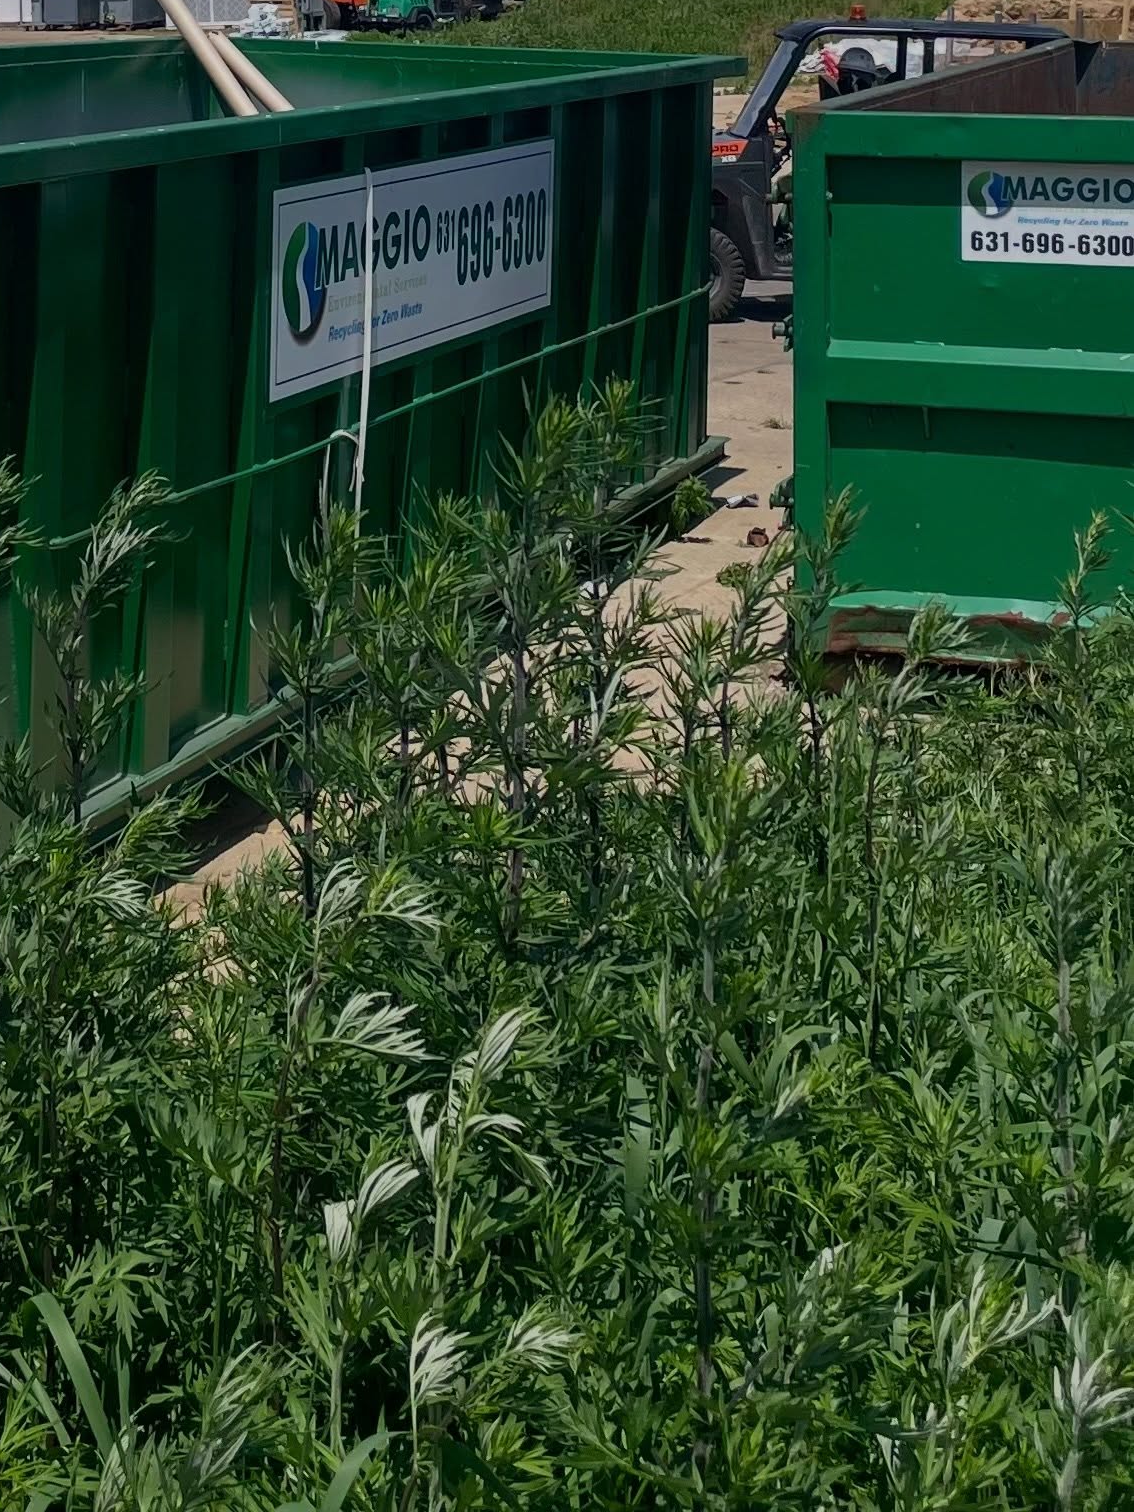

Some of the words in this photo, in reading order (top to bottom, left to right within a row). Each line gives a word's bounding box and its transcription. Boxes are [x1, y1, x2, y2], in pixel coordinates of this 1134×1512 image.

[1002, 175, 1134, 204] MAGGIO
[315, 204, 431, 289] MAGGIO
[436, 209, 456, 256] 631
[456, 188, 547, 286] 696-6300
[971, 230, 1134, 257] 631-696-6300
[381, 309, 399, 326] Zero
